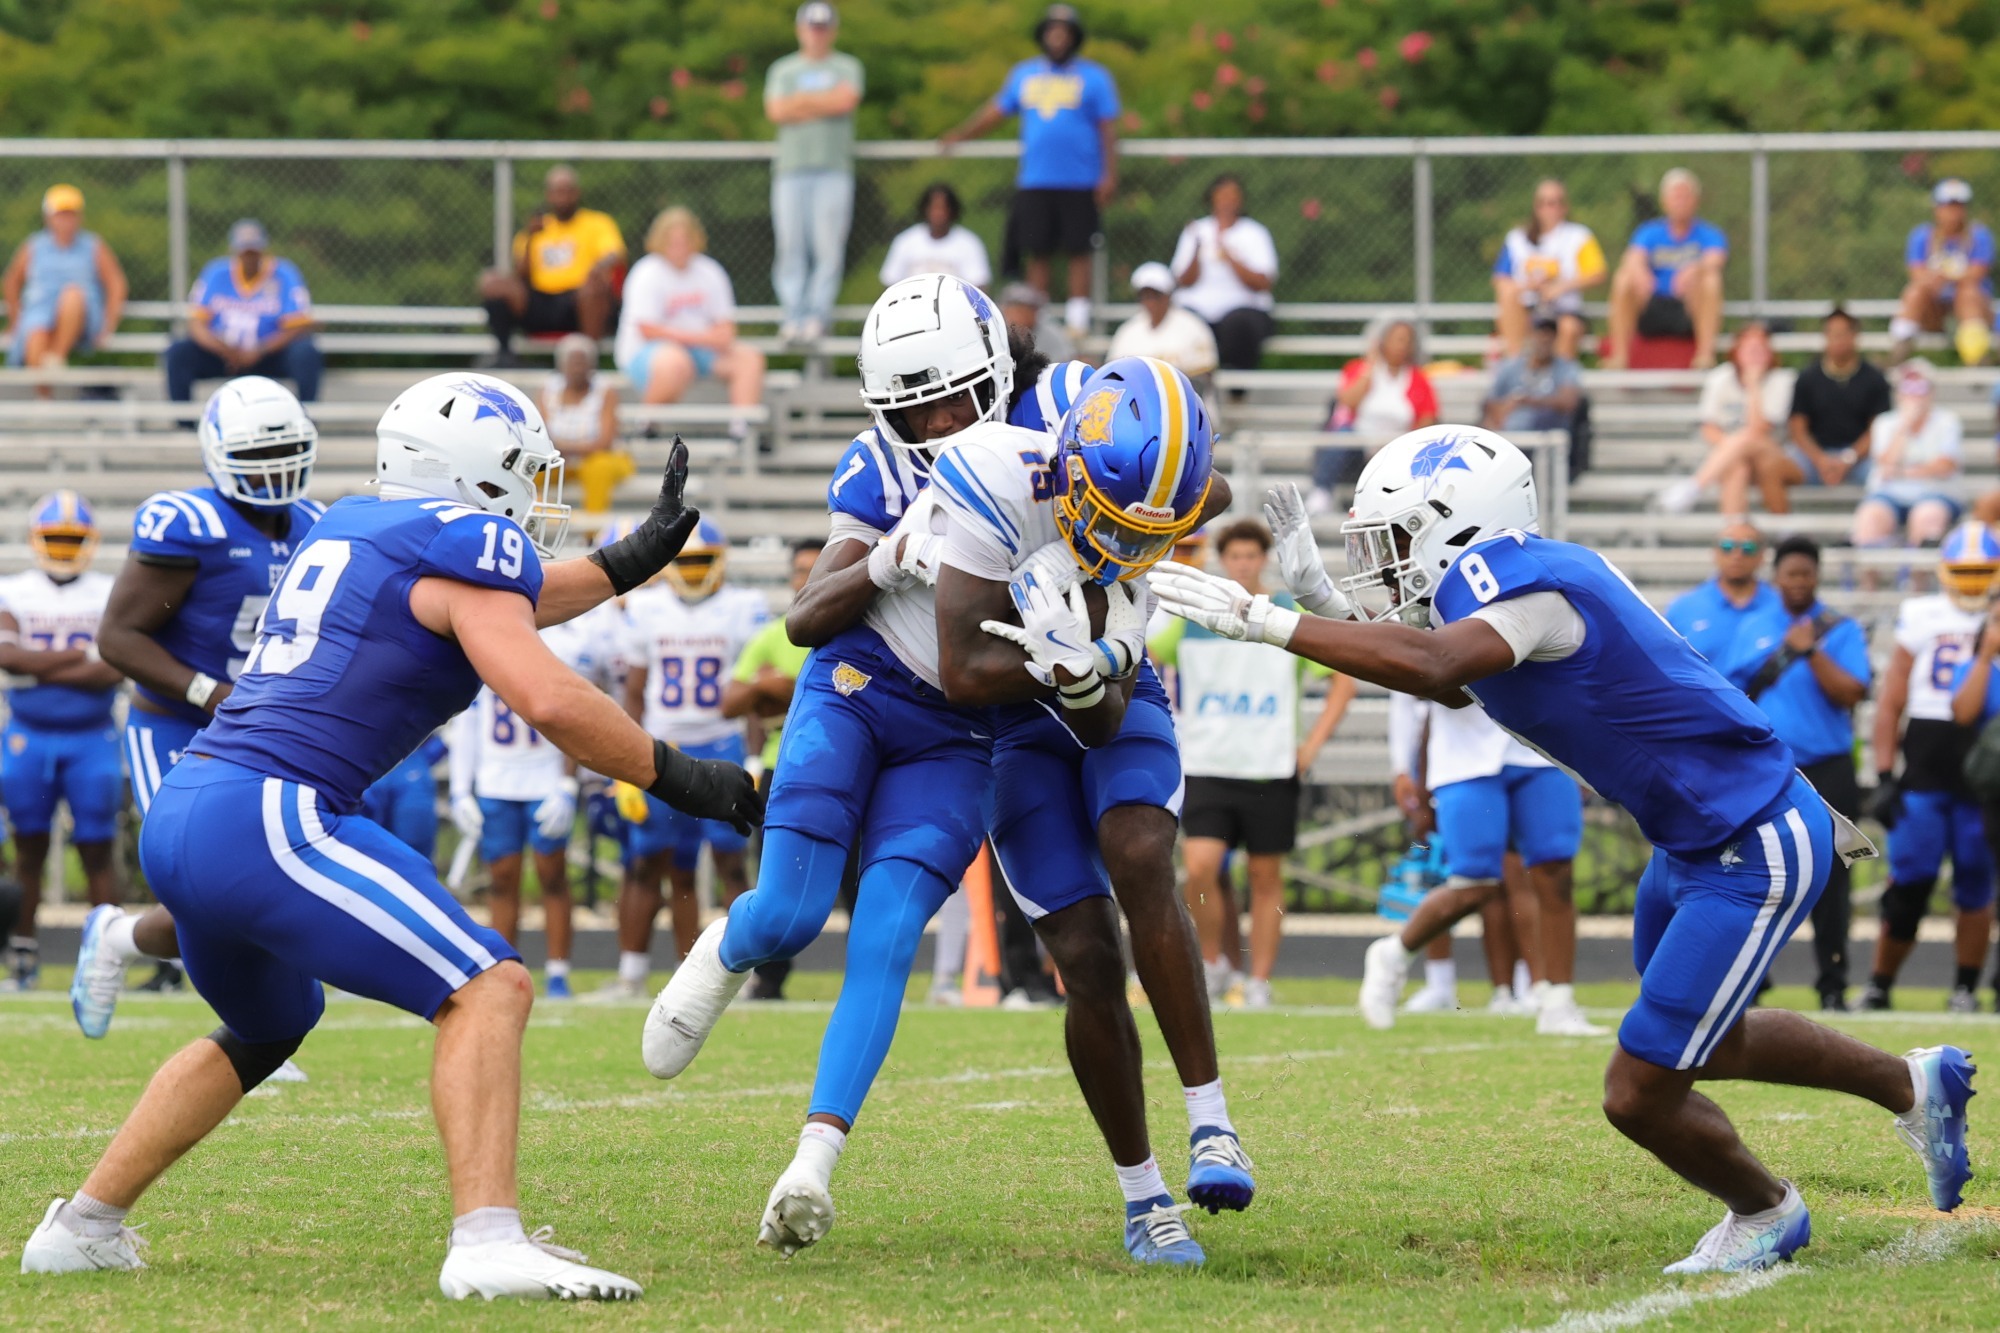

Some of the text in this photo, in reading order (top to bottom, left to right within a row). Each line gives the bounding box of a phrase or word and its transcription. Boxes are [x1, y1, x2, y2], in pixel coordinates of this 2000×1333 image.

[832, 451, 866, 498] 7
[136, 503, 179, 543] 57
[1134, 506, 1171, 519] Riddell
[475, 521, 524, 580] 19
[1459, 552, 1500, 604] 8
[661, 656, 721, 708] 88
